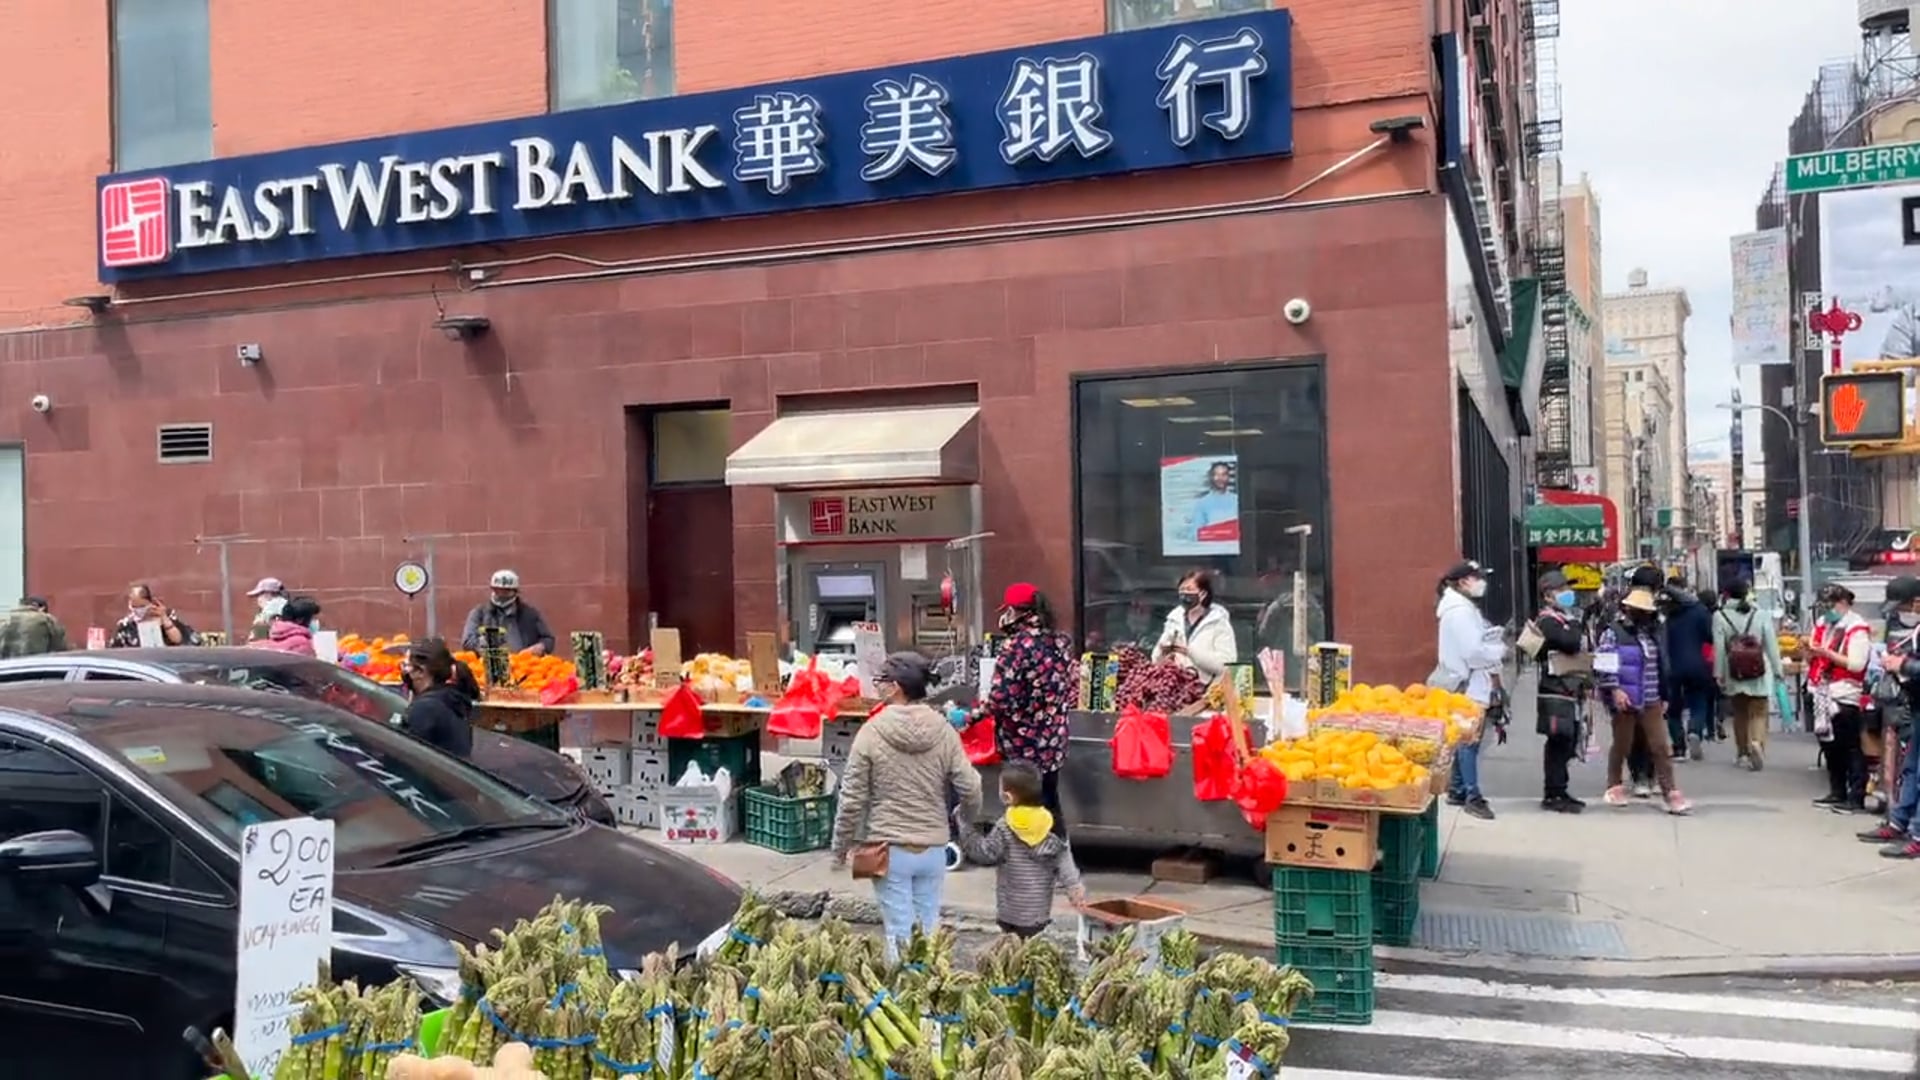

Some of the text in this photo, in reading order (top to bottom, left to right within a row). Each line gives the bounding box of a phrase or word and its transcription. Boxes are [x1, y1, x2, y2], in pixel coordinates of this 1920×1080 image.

[736, 30, 1268, 193] 華美銀行
[510, 125, 726, 210] BANK
[1797, 145, 1920, 179] MULBERRY
[848, 517, 897, 534] BANK
[288, 886, 325, 913] EA
